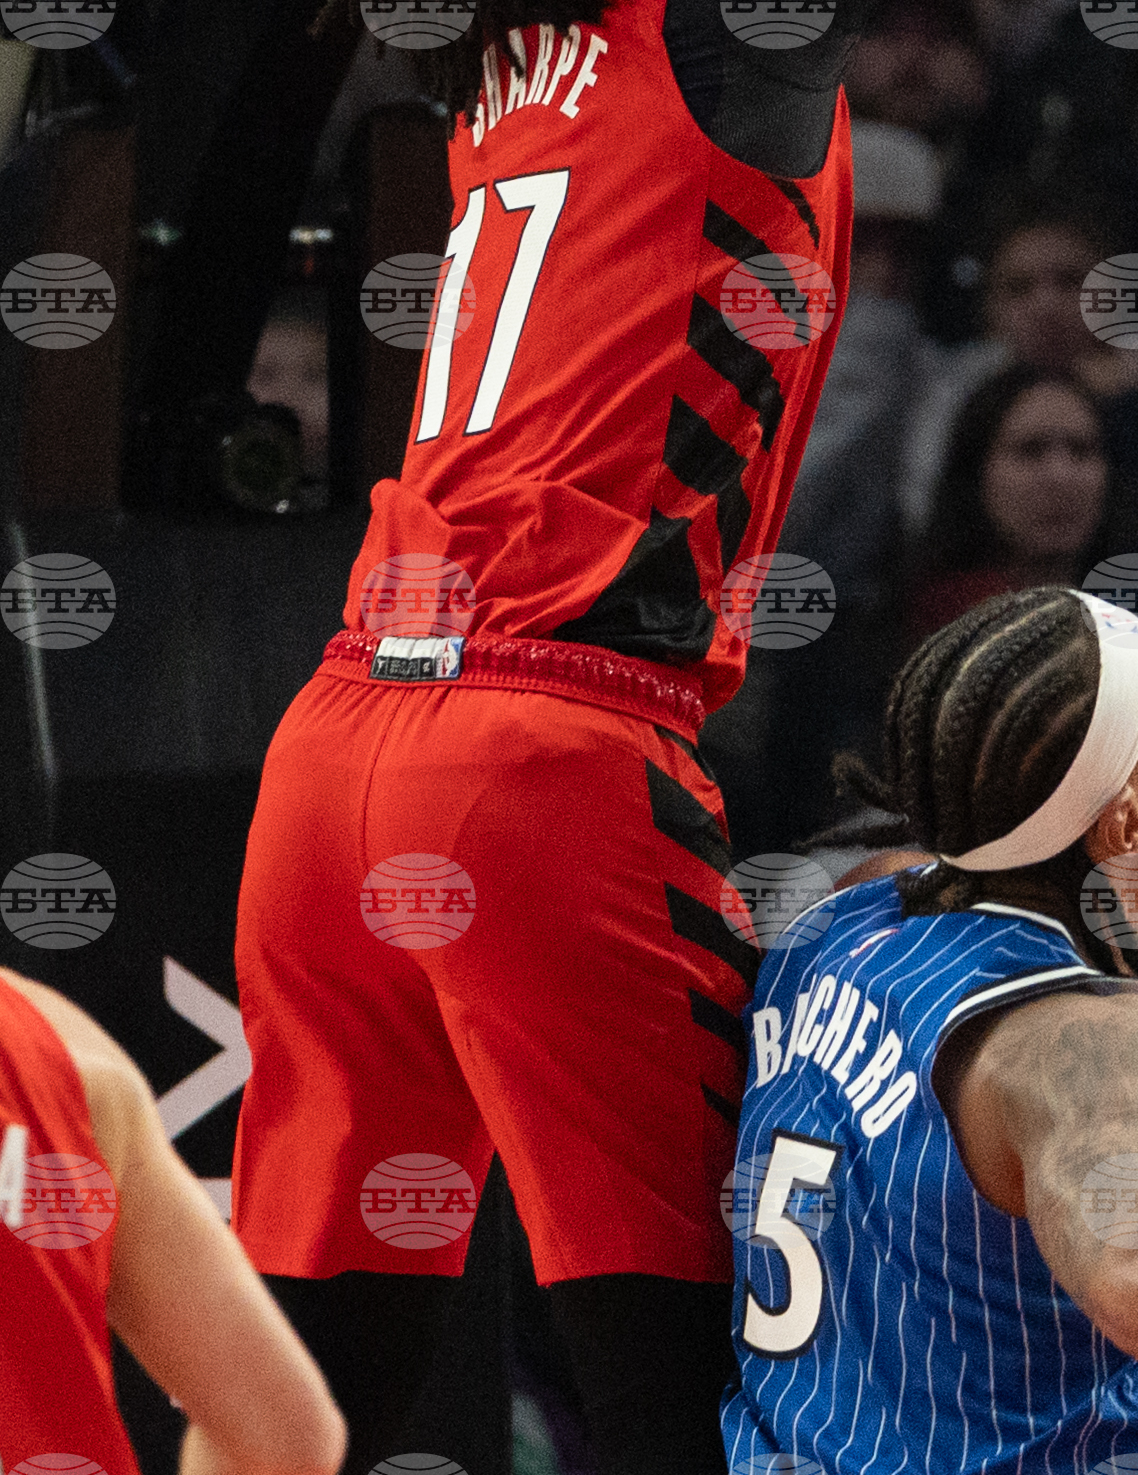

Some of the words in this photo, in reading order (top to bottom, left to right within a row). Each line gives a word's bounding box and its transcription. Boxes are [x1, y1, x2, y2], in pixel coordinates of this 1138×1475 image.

[416, 168, 571, 444] 17
[753, 974, 917, 1138] BCHERO
[742, 1130, 843, 1360] 5
